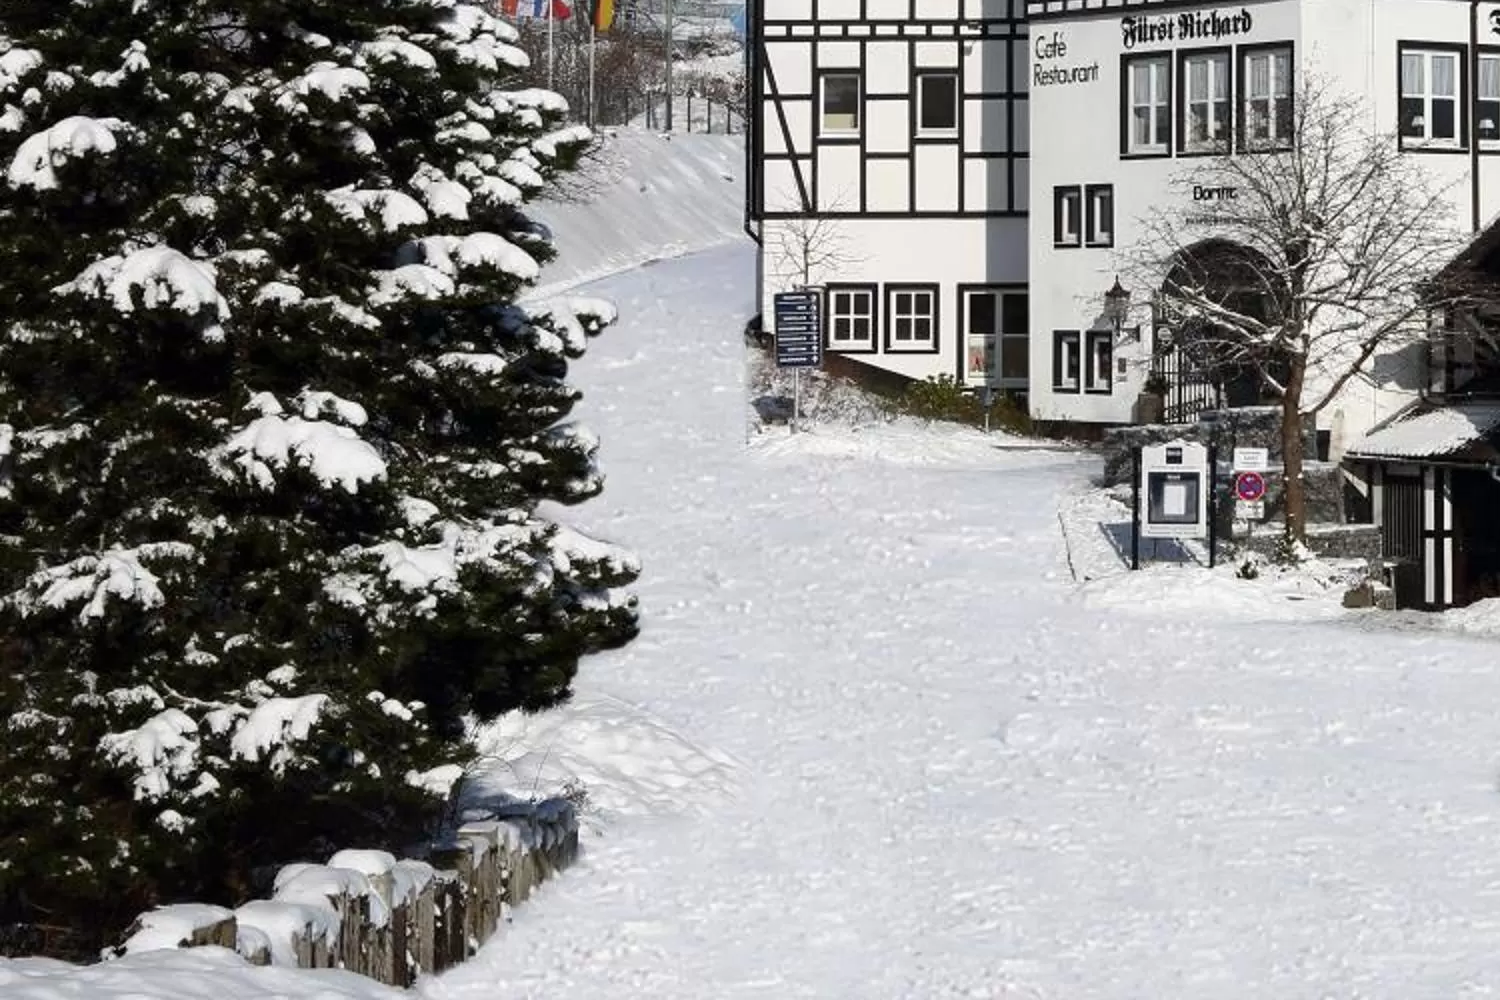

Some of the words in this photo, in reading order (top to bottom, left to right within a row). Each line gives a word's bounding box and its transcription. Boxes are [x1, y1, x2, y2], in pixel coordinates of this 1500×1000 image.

[1122, 15, 1175, 48] Fürst
[1178, 8, 1252, 40] Richard
[1035, 31, 1067, 59] Café
[1033, 63, 1099, 87] Restaurant
